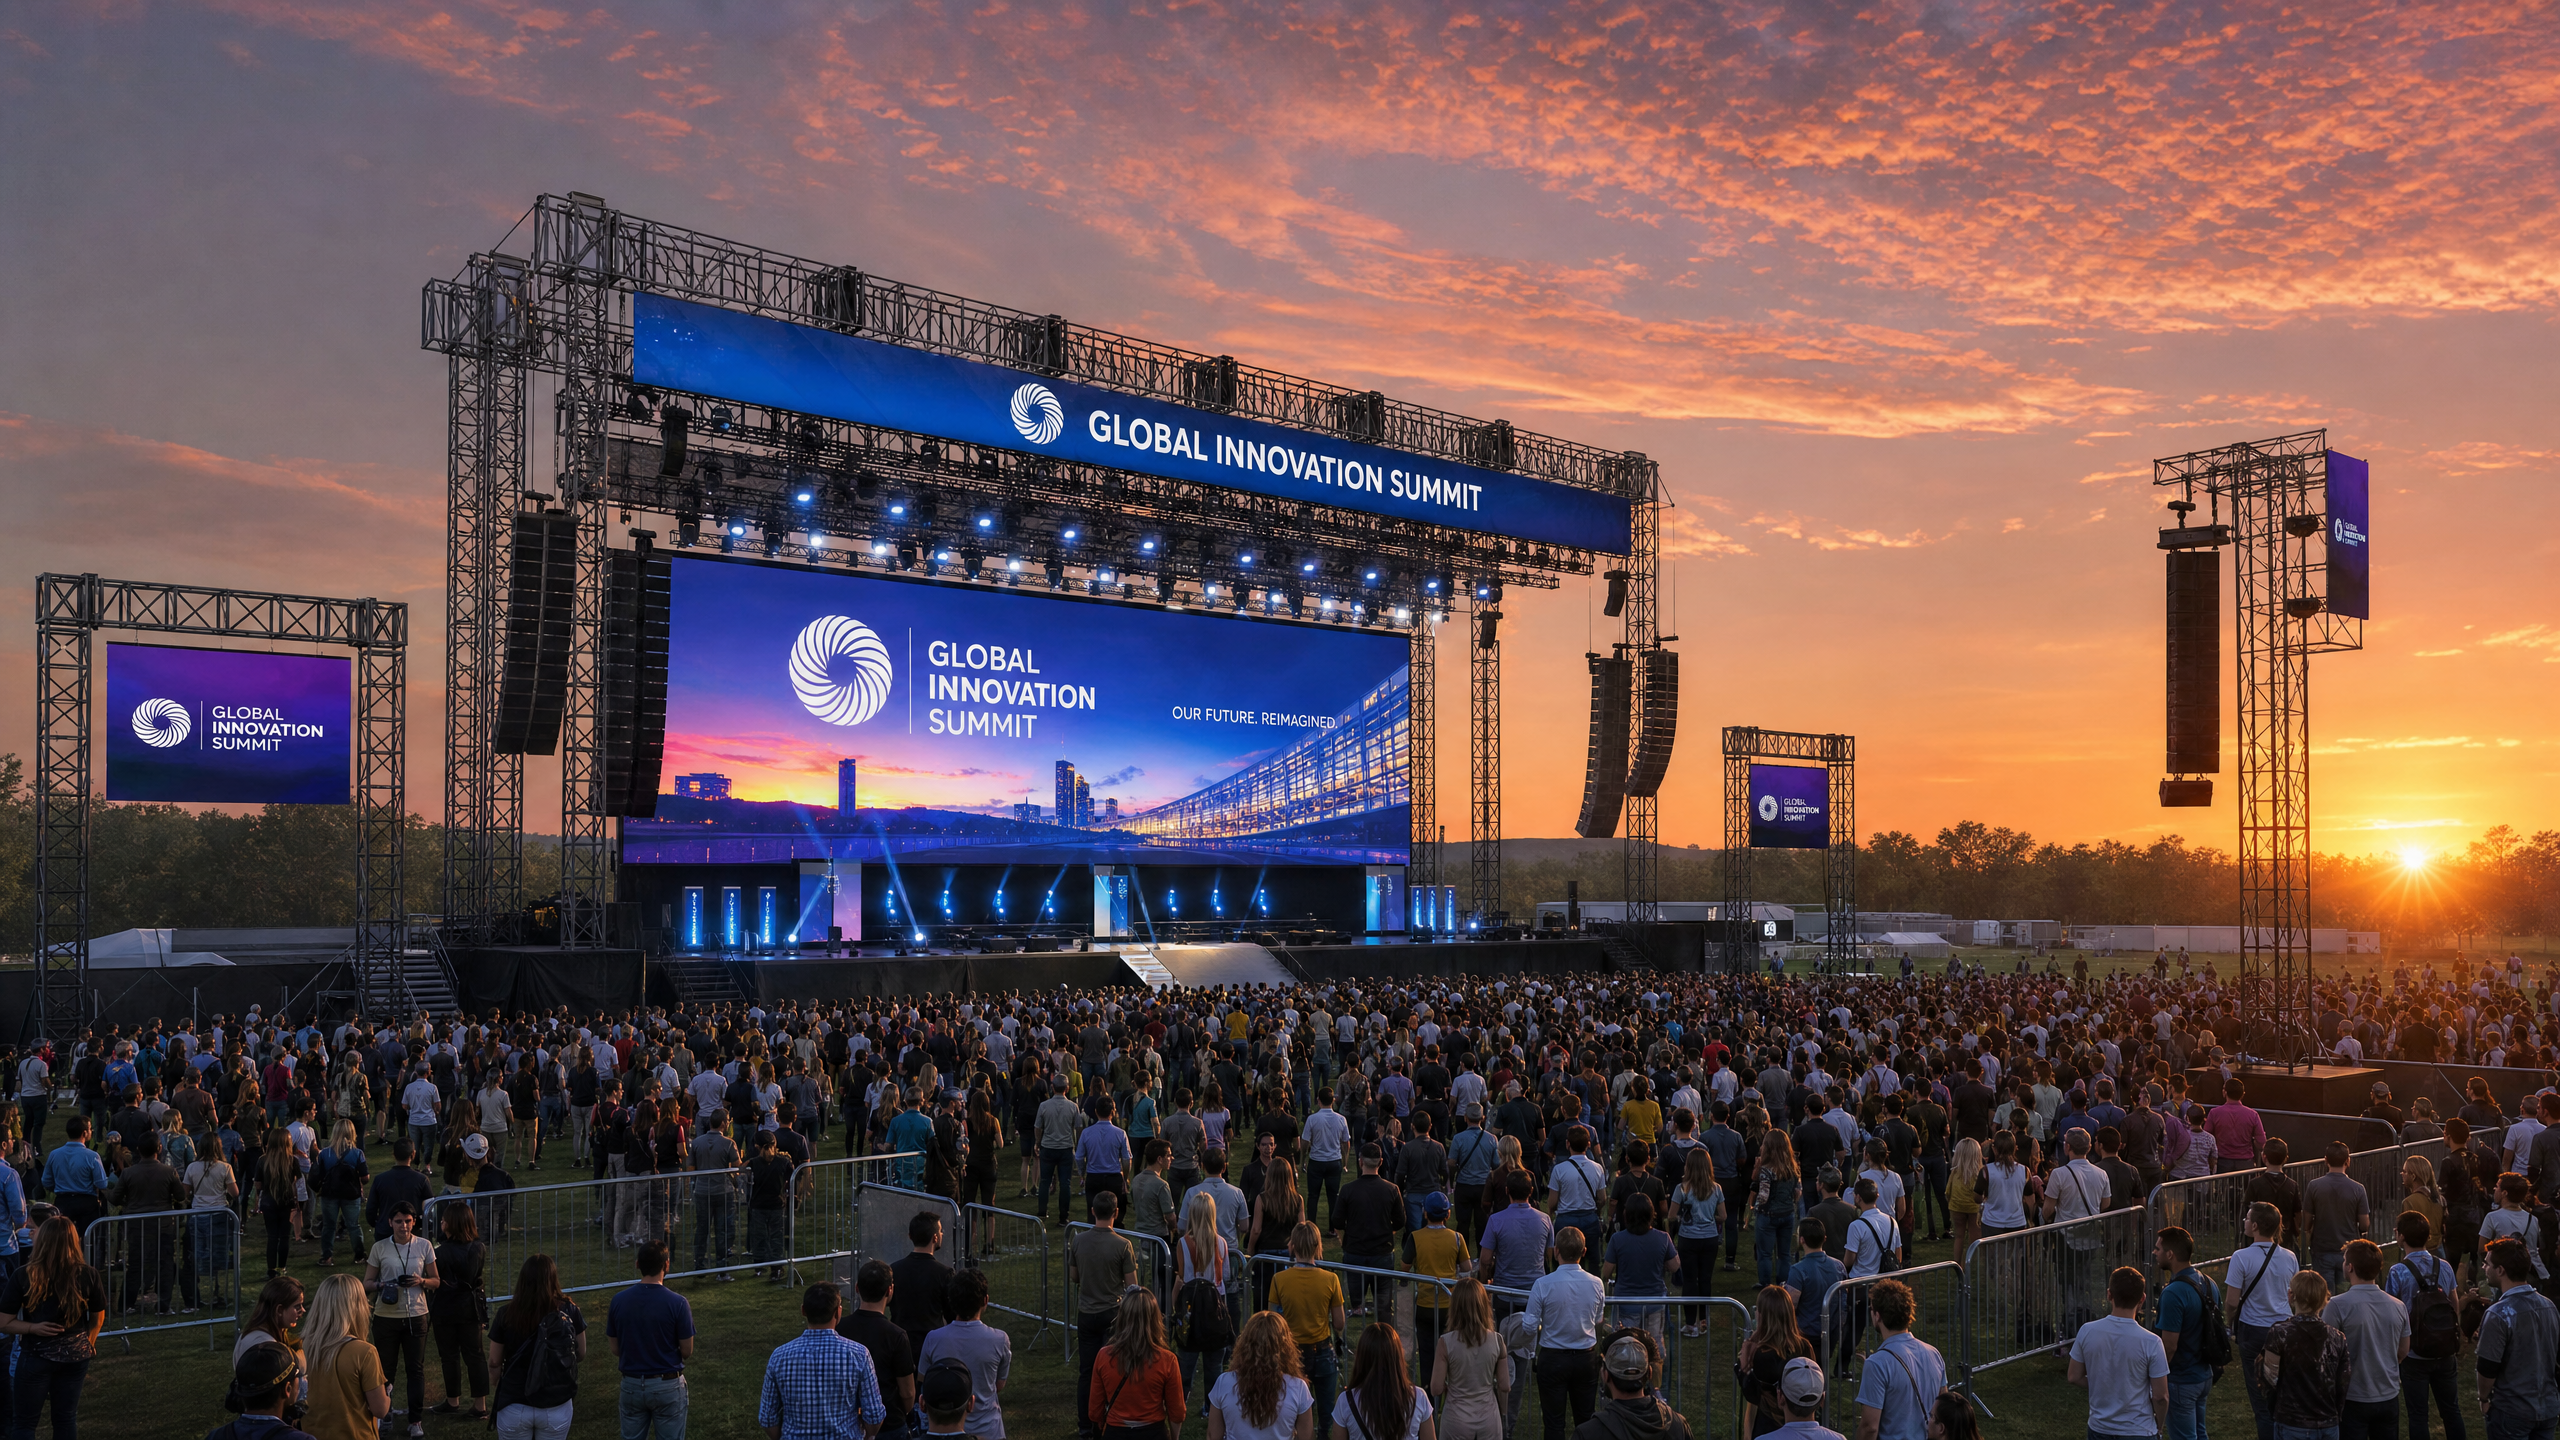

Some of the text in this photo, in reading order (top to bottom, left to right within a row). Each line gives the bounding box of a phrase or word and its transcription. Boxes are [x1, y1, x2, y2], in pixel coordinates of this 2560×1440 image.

[1088, 410, 1482, 511] GLOBAL INNOVATION SUMMIT
[928, 640, 1041, 674] GLOBAL
[929, 674, 1095, 710] INNOVATION
[212, 705, 284, 720] GLOBAL
[928, 708, 1038, 739] SUMMIT
[1172, 706, 1338, 729] OUR FUTURE. REIMAGINED.
[212, 721, 324, 738] INNOVATION
[212, 737, 282, 751] SUMMIT
